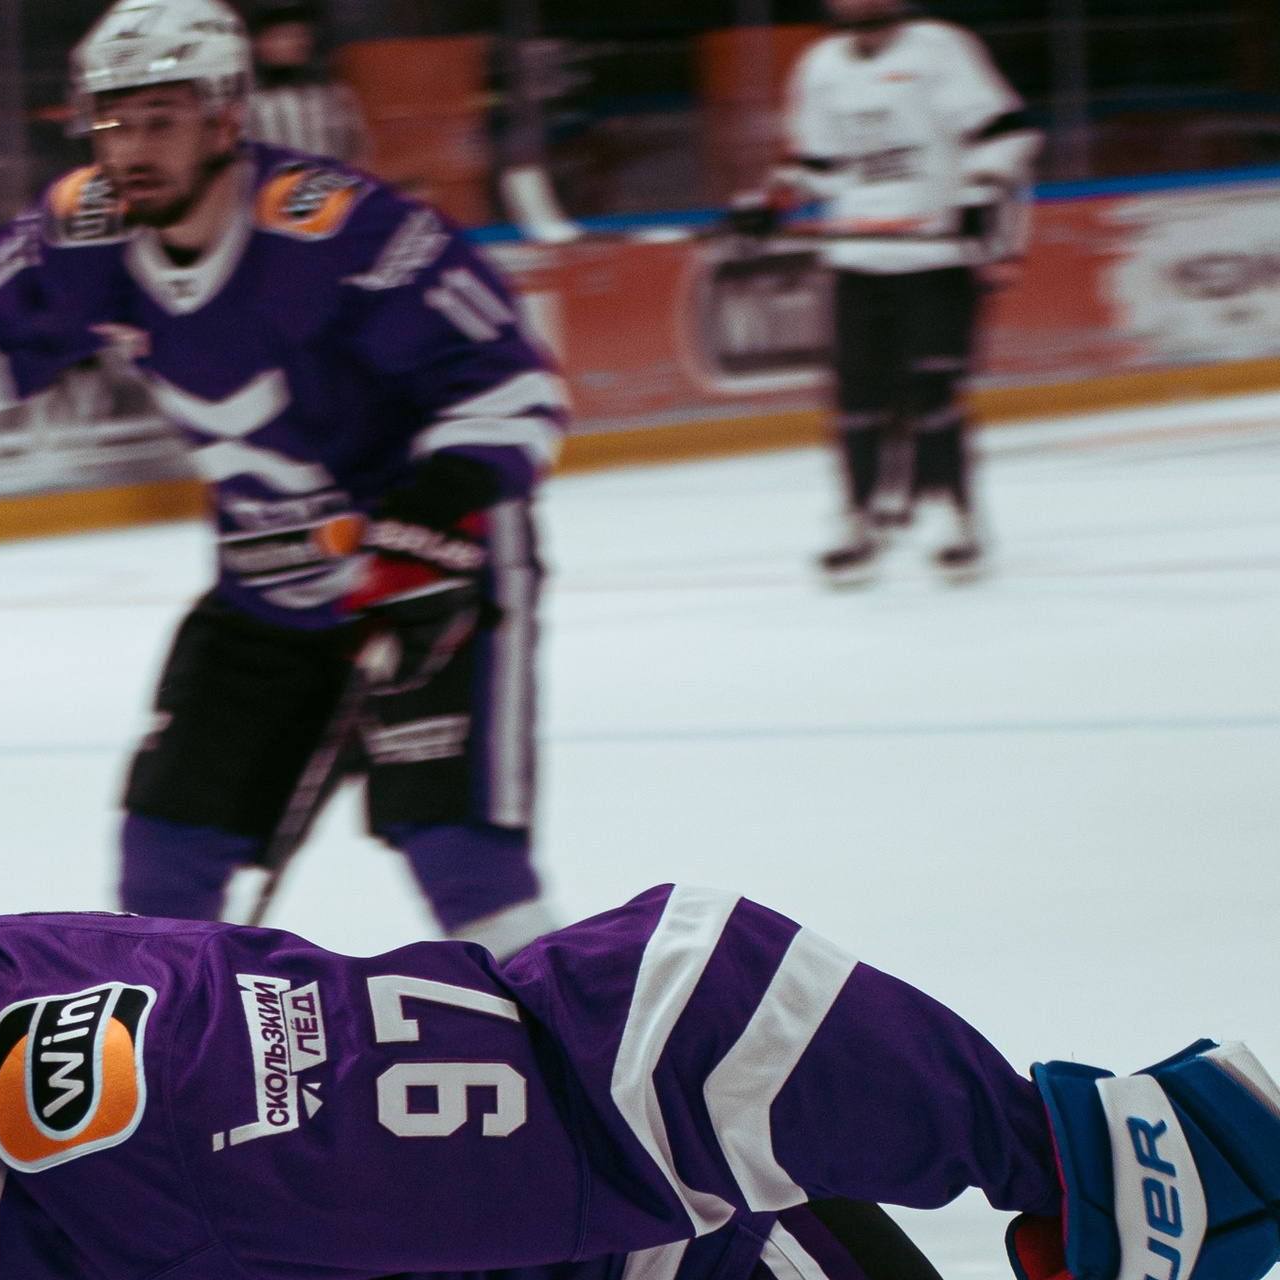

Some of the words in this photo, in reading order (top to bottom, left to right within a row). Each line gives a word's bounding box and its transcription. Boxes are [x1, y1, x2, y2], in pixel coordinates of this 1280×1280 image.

[41, 994, 102, 1119] Win
[290, 991, 321, 1056] ЛЁД
[366, 974, 528, 1138] 97
